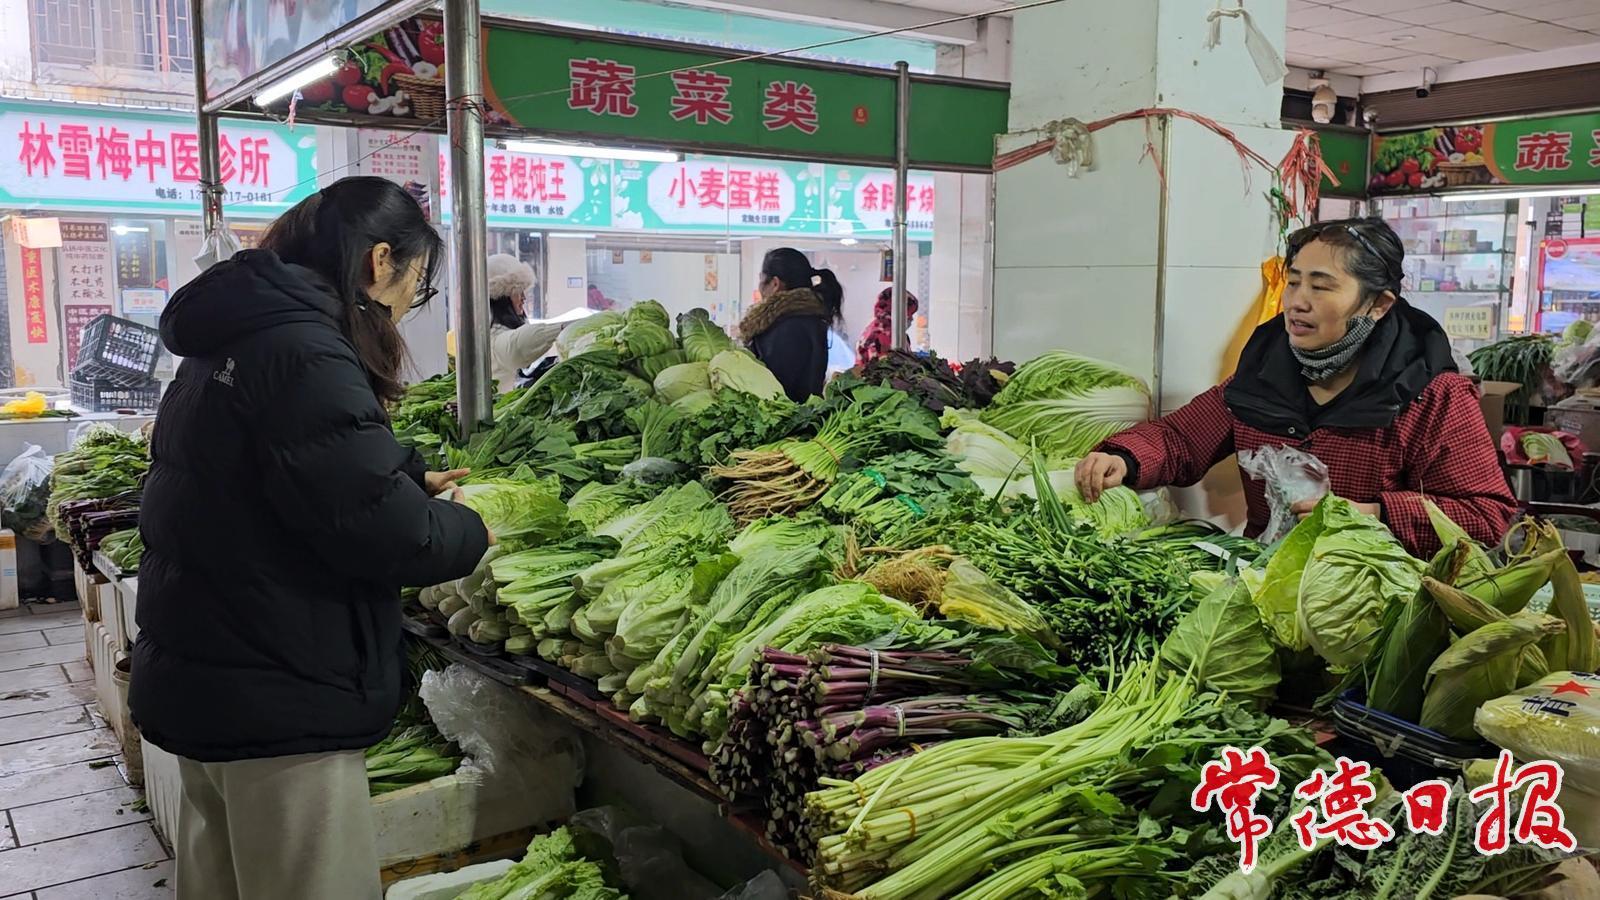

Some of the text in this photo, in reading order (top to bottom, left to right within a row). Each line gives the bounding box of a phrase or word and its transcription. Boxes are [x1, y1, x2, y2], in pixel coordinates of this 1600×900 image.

[568, 58, 819, 133] 蔬菜类
[18, 121, 270, 187] 林雪梅中医诊所
[1516, 130, 1600, 171] 蔬
[484, 153, 567, 201] 香馄饨王
[668, 167, 780, 210] 小麦蛋糕
[213, 371, 234, 387] CAMEL
